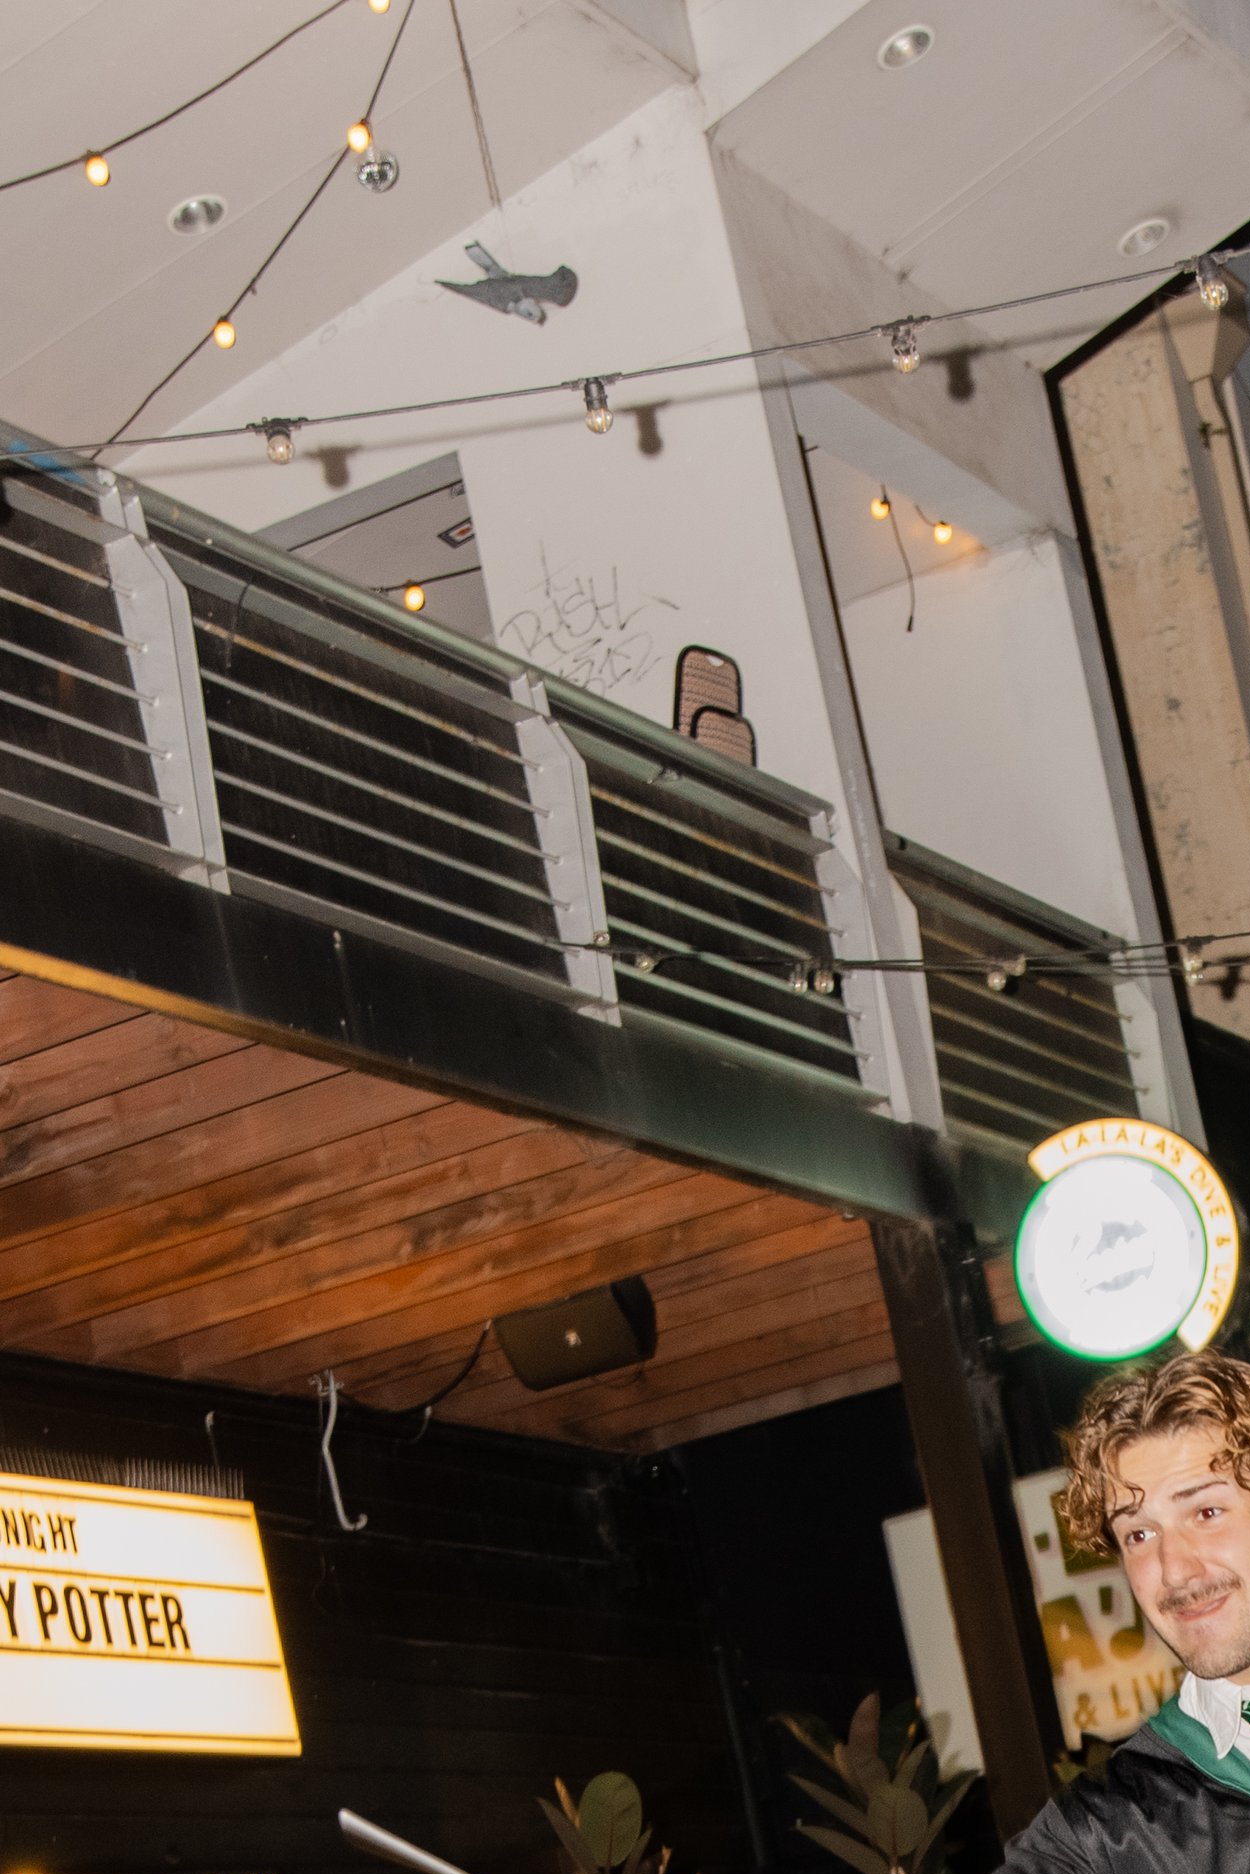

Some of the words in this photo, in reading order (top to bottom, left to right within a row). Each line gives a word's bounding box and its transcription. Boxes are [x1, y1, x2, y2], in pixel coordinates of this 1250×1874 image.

[1189, 1166, 1227, 1219] DIVE
[0, 1507, 78, 1554] NIGHT
[33, 1580, 192, 1651] POTTER
